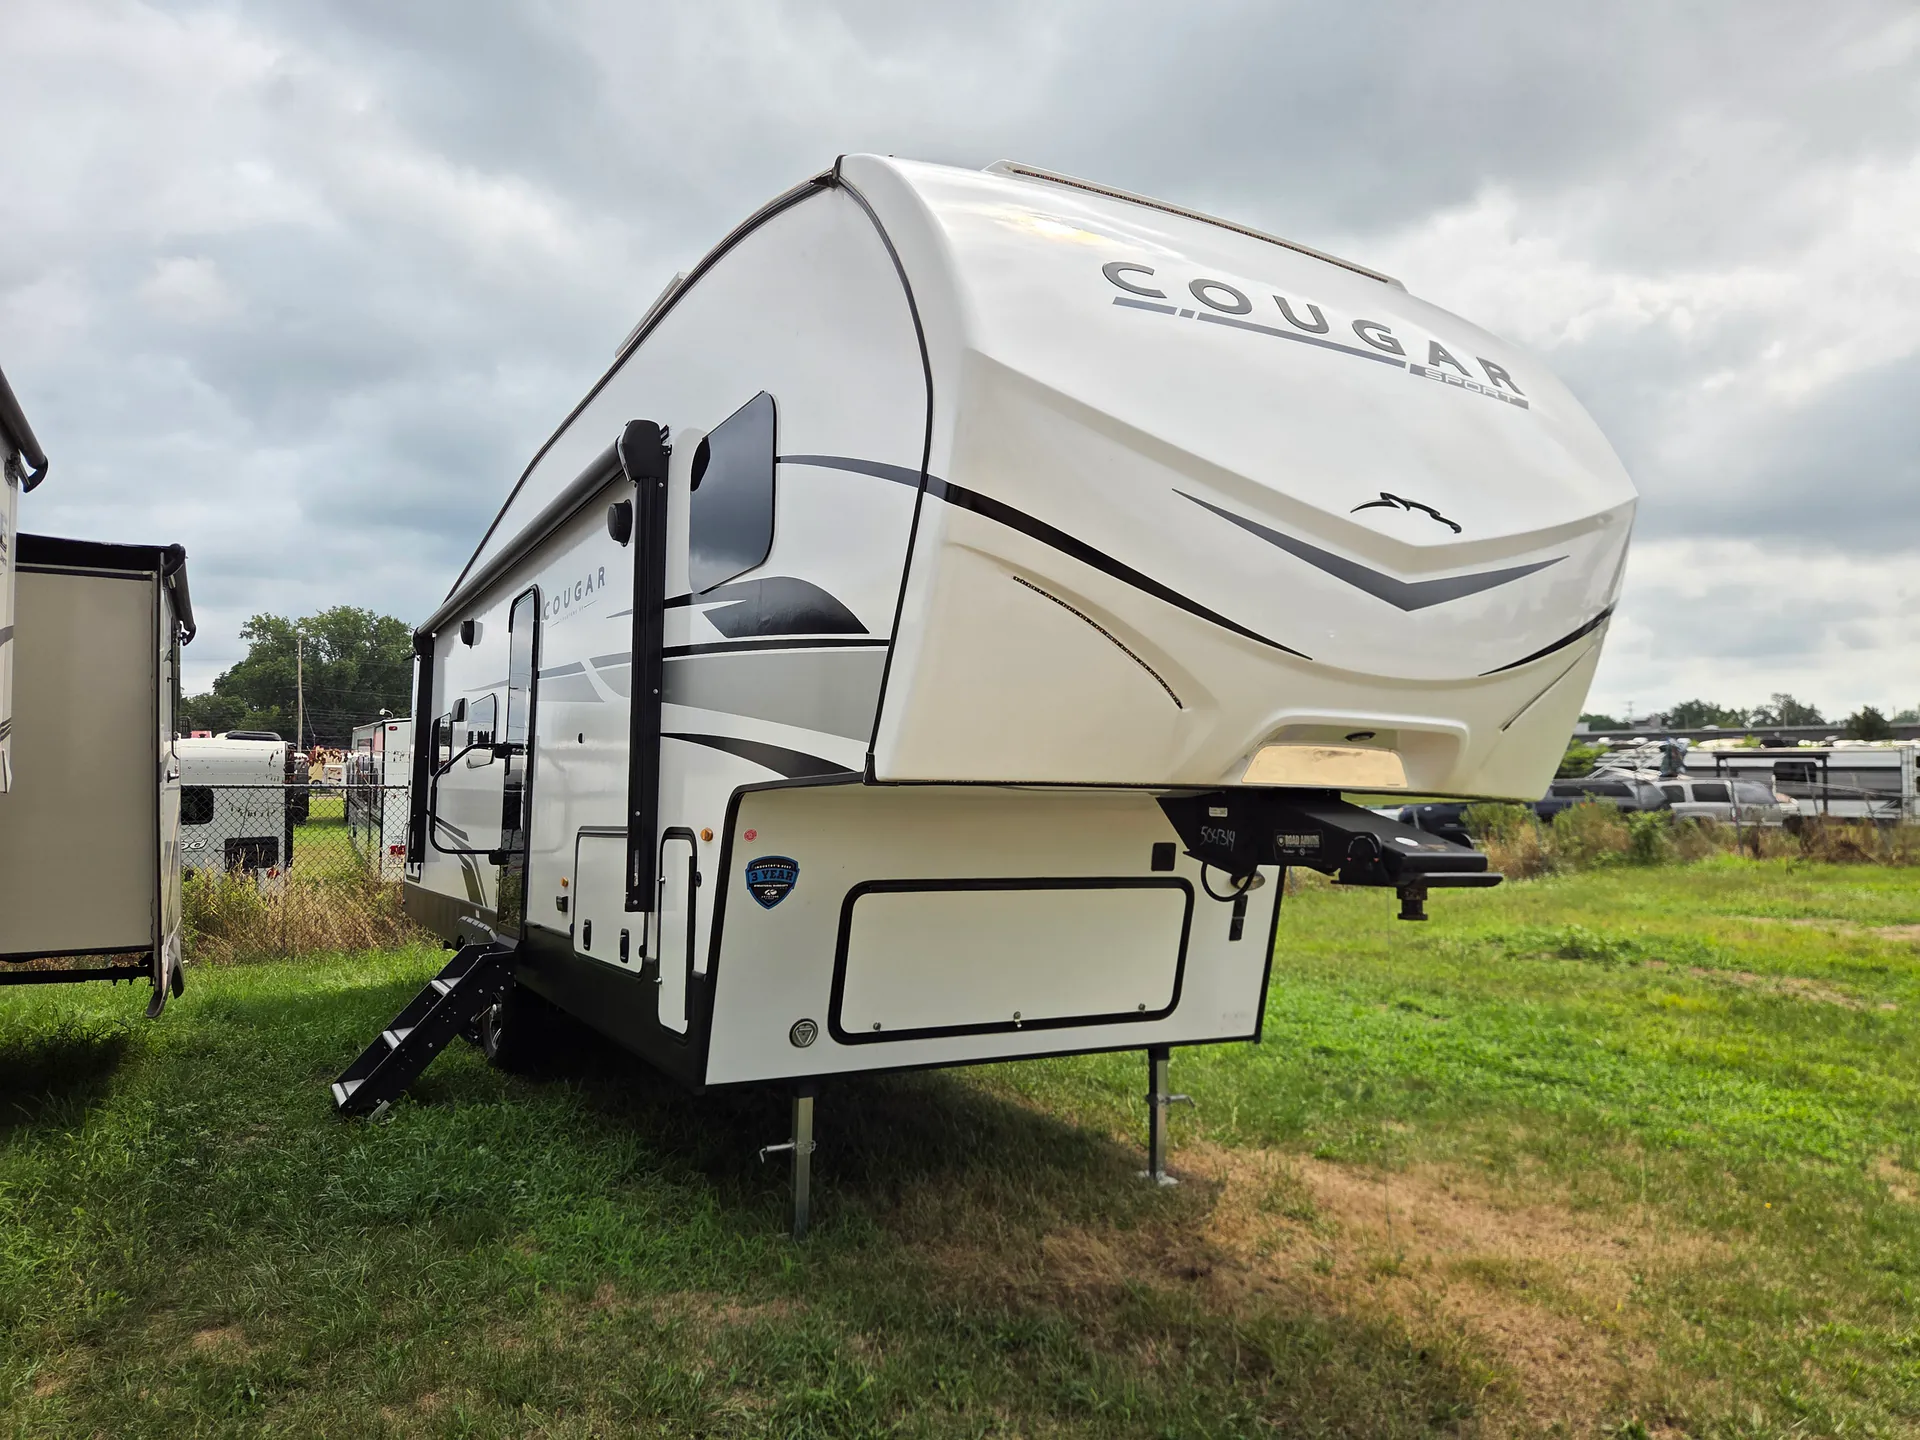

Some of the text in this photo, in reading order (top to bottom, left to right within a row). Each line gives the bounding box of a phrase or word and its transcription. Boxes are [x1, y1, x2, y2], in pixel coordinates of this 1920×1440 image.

[1102, 261, 1526, 397] COUGAR
[1424, 368, 1517, 403] SPORT
[543, 566, 605, 620] COUGAR
[761, 870, 793, 881] YEAR
